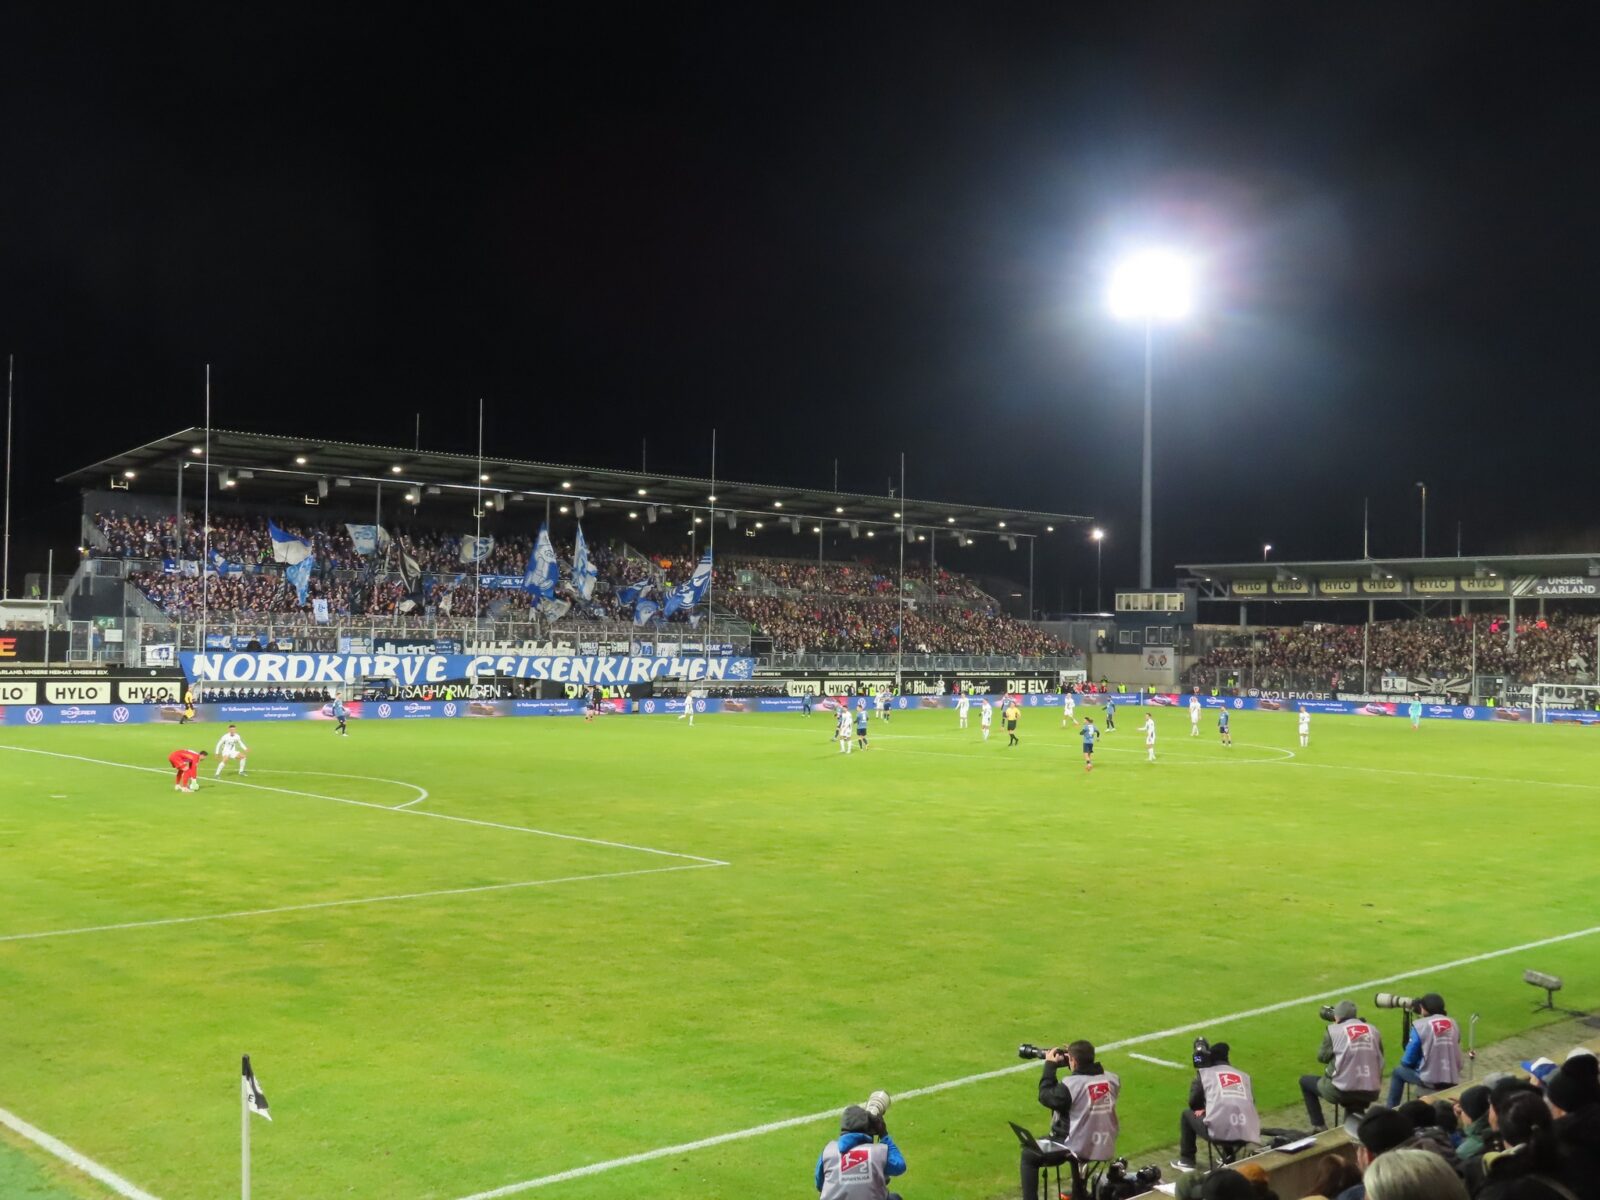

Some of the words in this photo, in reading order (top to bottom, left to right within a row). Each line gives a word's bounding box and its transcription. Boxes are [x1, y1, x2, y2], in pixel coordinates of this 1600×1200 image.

[1420, 580, 1448, 589] HYLO
[1467, 579, 1496, 588] HYLO
[1547, 576, 1583, 585] UNSER
[1237, 583, 1261, 591] HYLO
[1277, 583, 1302, 591] HYLO
[1325, 582, 1350, 590] HYLO
[1368, 581, 1395, 590] HYLO
[1536, 586, 1596, 594] SAARLAND
[193, 653, 448, 685] NORDKURVE
[465, 655, 730, 685] GEISENKIRCHEN
[791, 684, 814, 693] HYLO
[1006, 680, 1026, 694] DIE
[0, 687, 23, 700] LO
[55, 687, 98, 699] HYLO
[128, 686, 168, 699] HYLO
[1230, 1112, 1247, 1126] 09
[1092, 1131, 1110, 1146] 07
